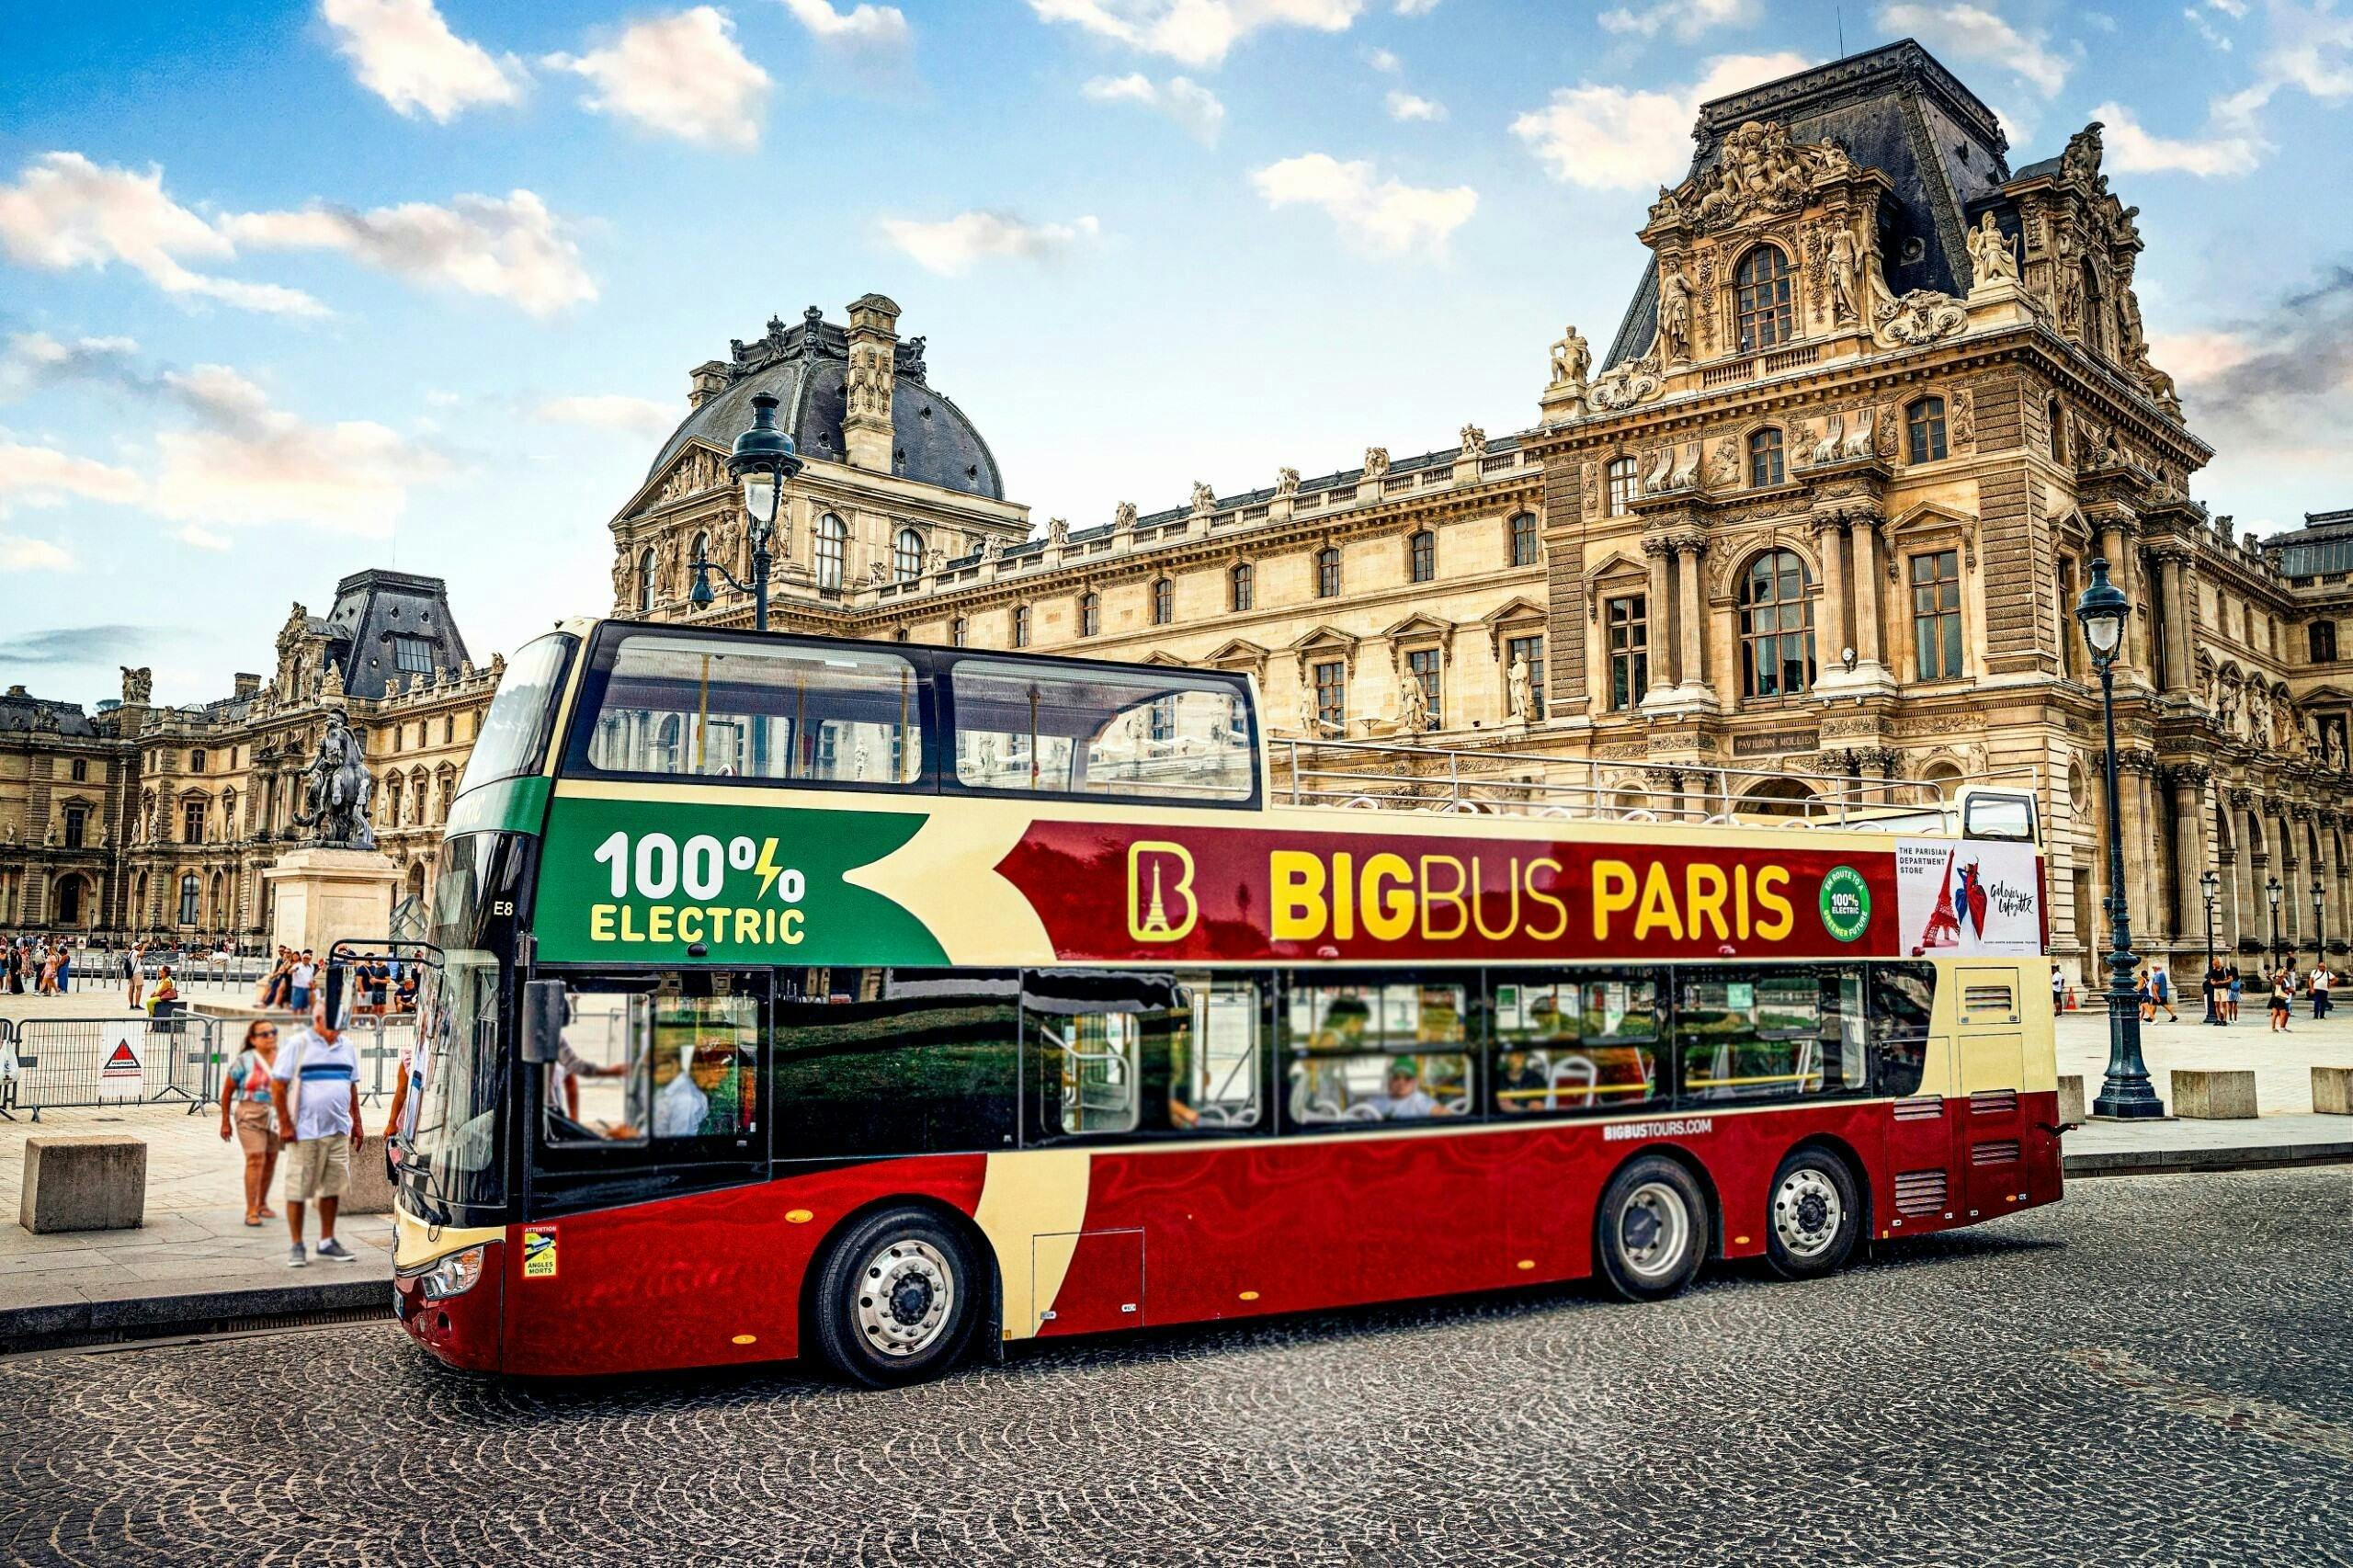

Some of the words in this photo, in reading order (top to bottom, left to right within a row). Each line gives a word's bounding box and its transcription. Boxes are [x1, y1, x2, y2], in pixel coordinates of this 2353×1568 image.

[1737, 738, 1775, 750] PAVILLON
[1779, 734, 1815, 746] MOLLIEN
[1899, 846, 1913, 855] THE
[1915, 847, 1947, 856] PARISIAN
[594, 831, 805, 903] 100%
[1899, 857, 1945, 866] DEPARTMENT
[1900, 866, 1924, 874] STORE
[1824, 878, 1834, 892] EN
[1831, 869, 1852, 881] ROUTE
[1852, 874, 1860, 884] TO
[1592, 859, 1794, 941] PARIS
[1831, 893, 1859, 907] 100%
[493, 901, 514, 916] E8
[1831, 906, 1859, 915] ELECTRIC
[590, 903, 805, 945] ELECTRIC
[1824, 909, 1848, 937] GREENER
[1848, 910, 1868, 937] FUTURE
[1603, 1119, 1712, 1141] BIGBUSTOURS.COM
